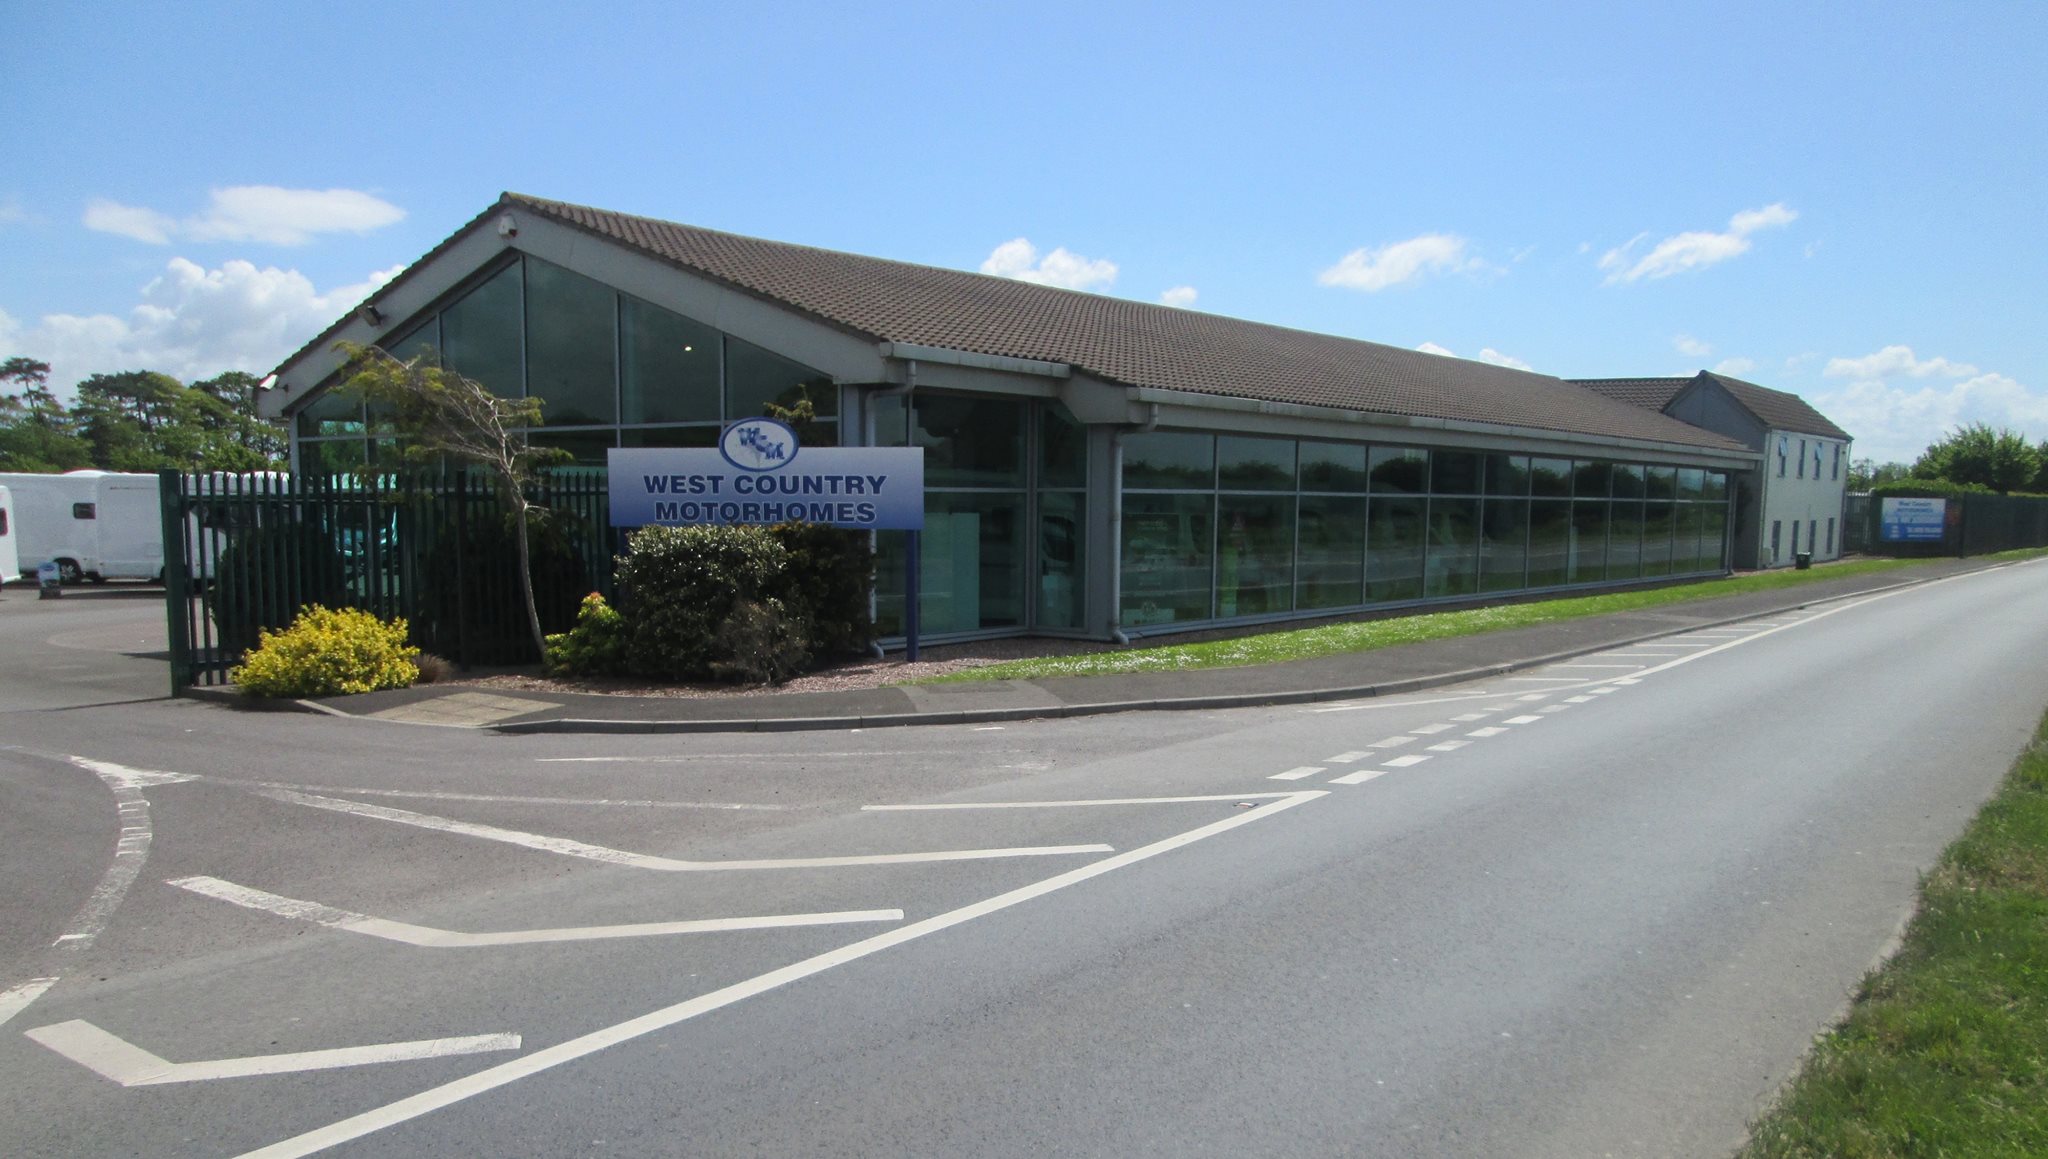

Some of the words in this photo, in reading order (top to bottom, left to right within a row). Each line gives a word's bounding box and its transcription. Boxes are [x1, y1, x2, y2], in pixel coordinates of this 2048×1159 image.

[643, 474, 724, 494] WEST
[734, 474, 887, 495] COUNTRY
[655, 502, 876, 523] MOTORHOMES
